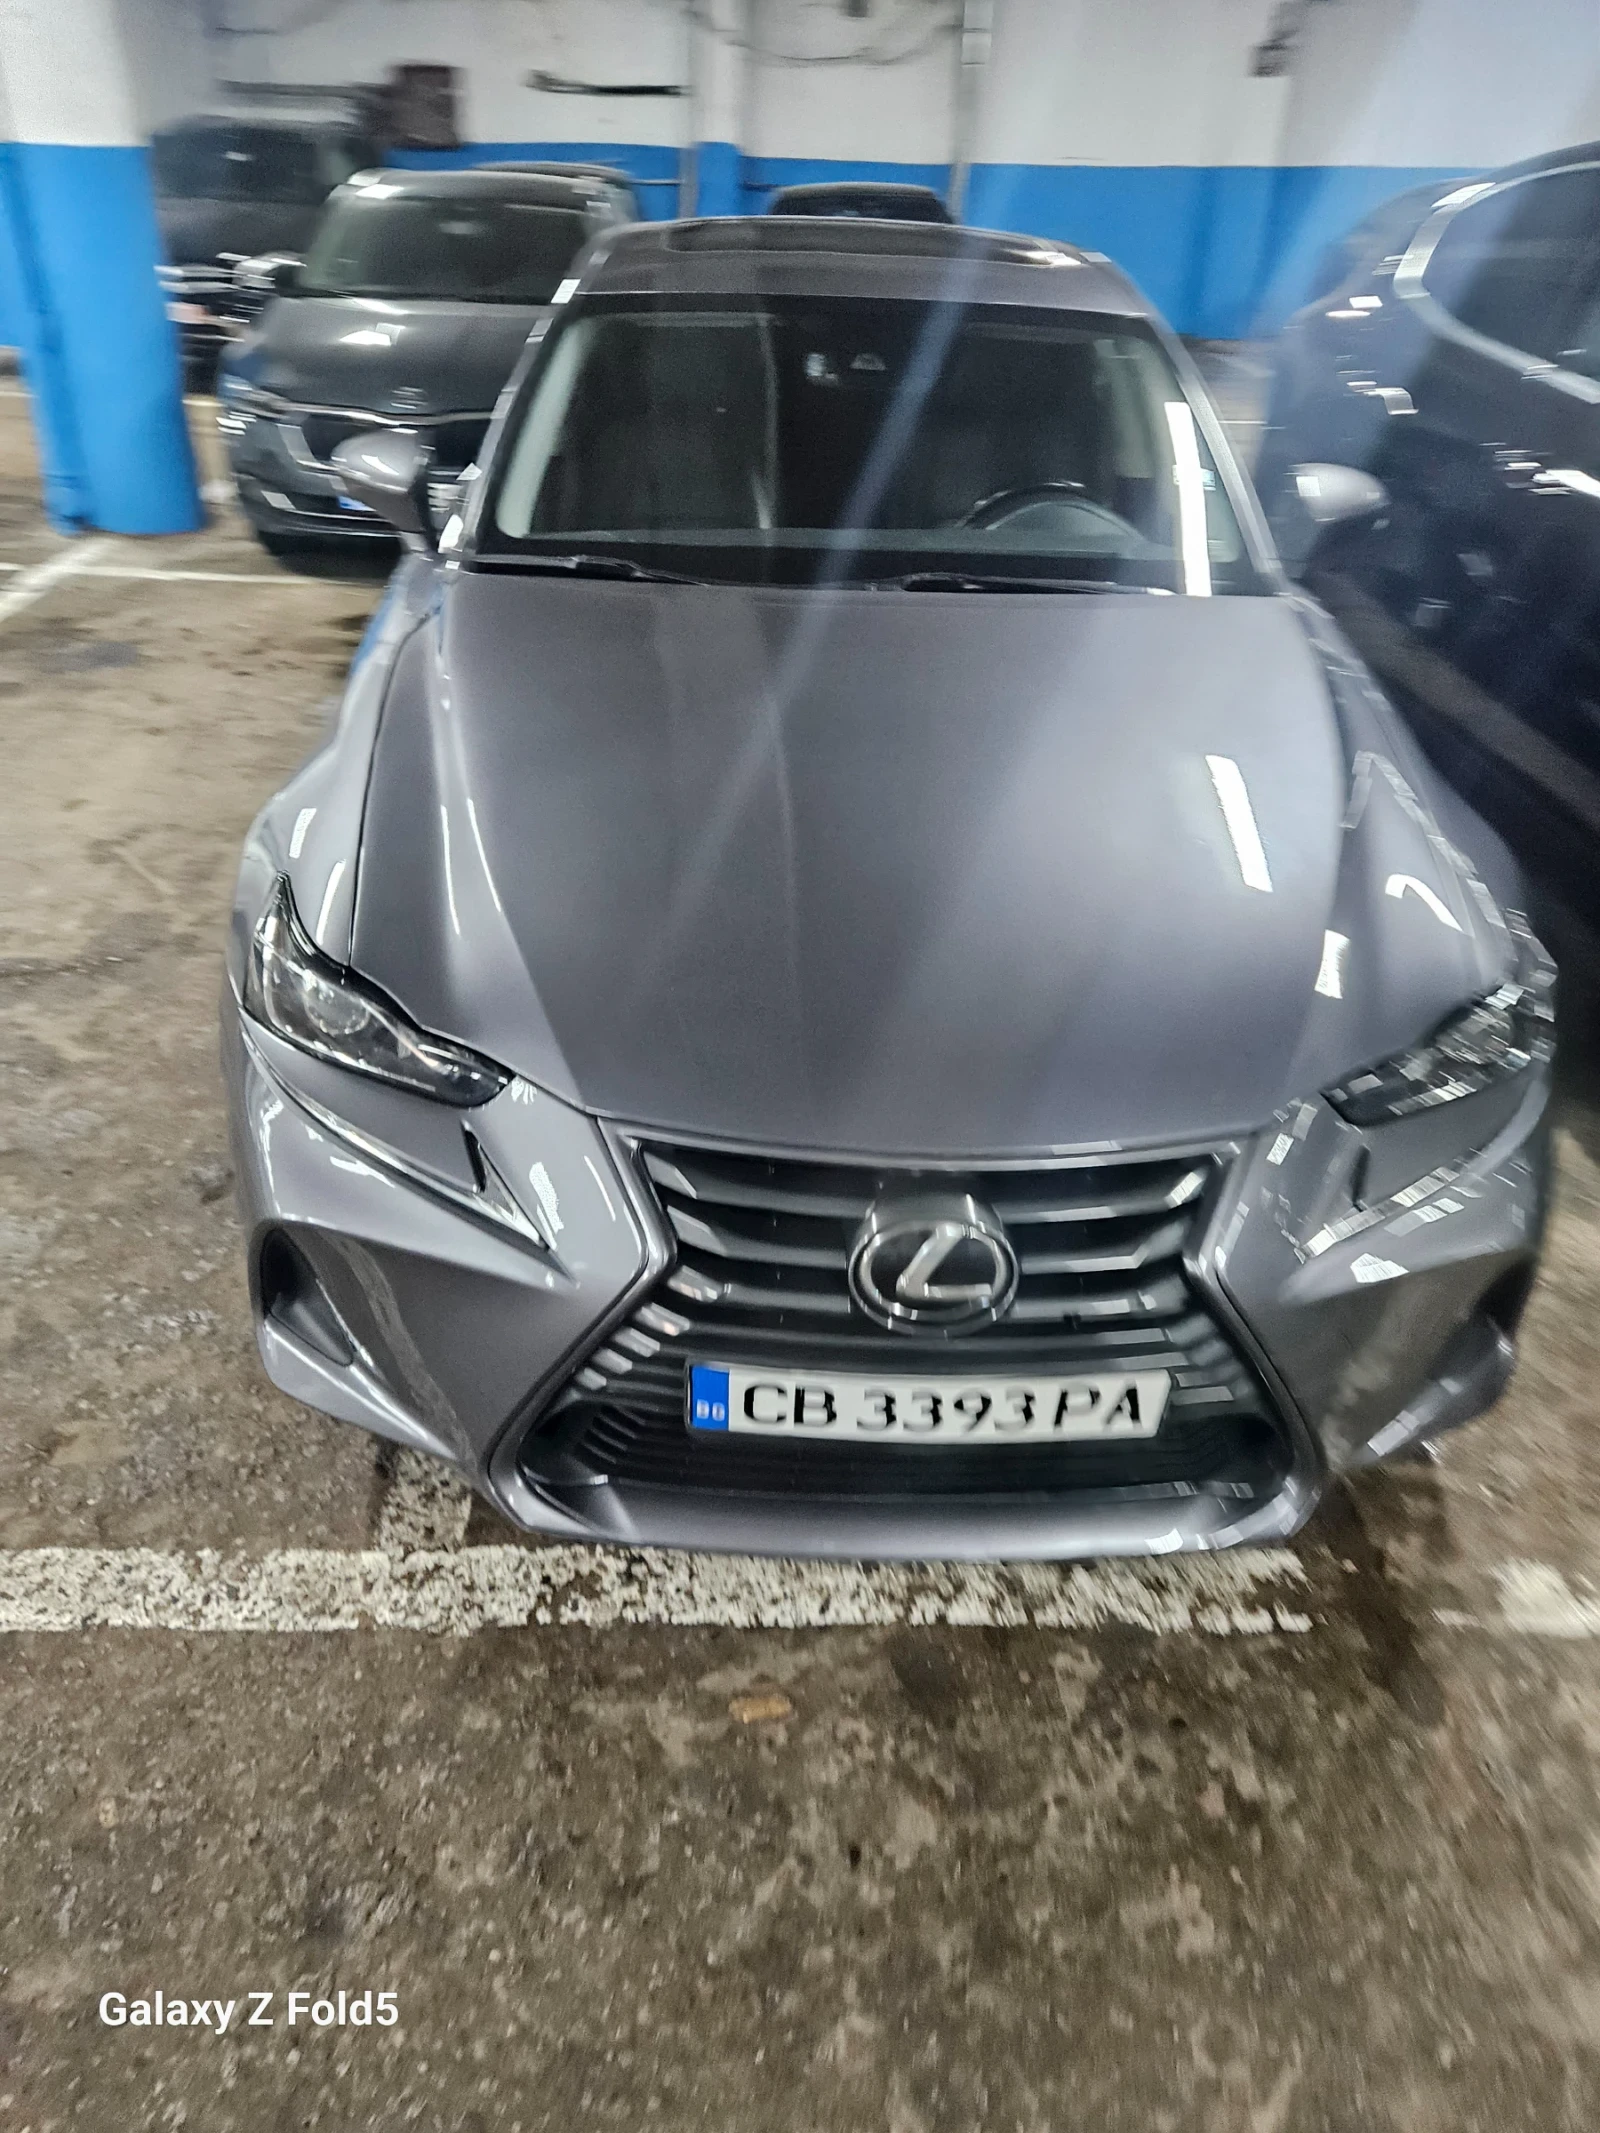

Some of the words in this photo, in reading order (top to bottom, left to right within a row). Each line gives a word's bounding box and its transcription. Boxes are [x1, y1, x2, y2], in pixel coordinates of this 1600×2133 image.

[744, 1381, 838, 1427] CB
[856, 1386, 1037, 1434] 3393
[1053, 1379, 1145, 1434] PA
